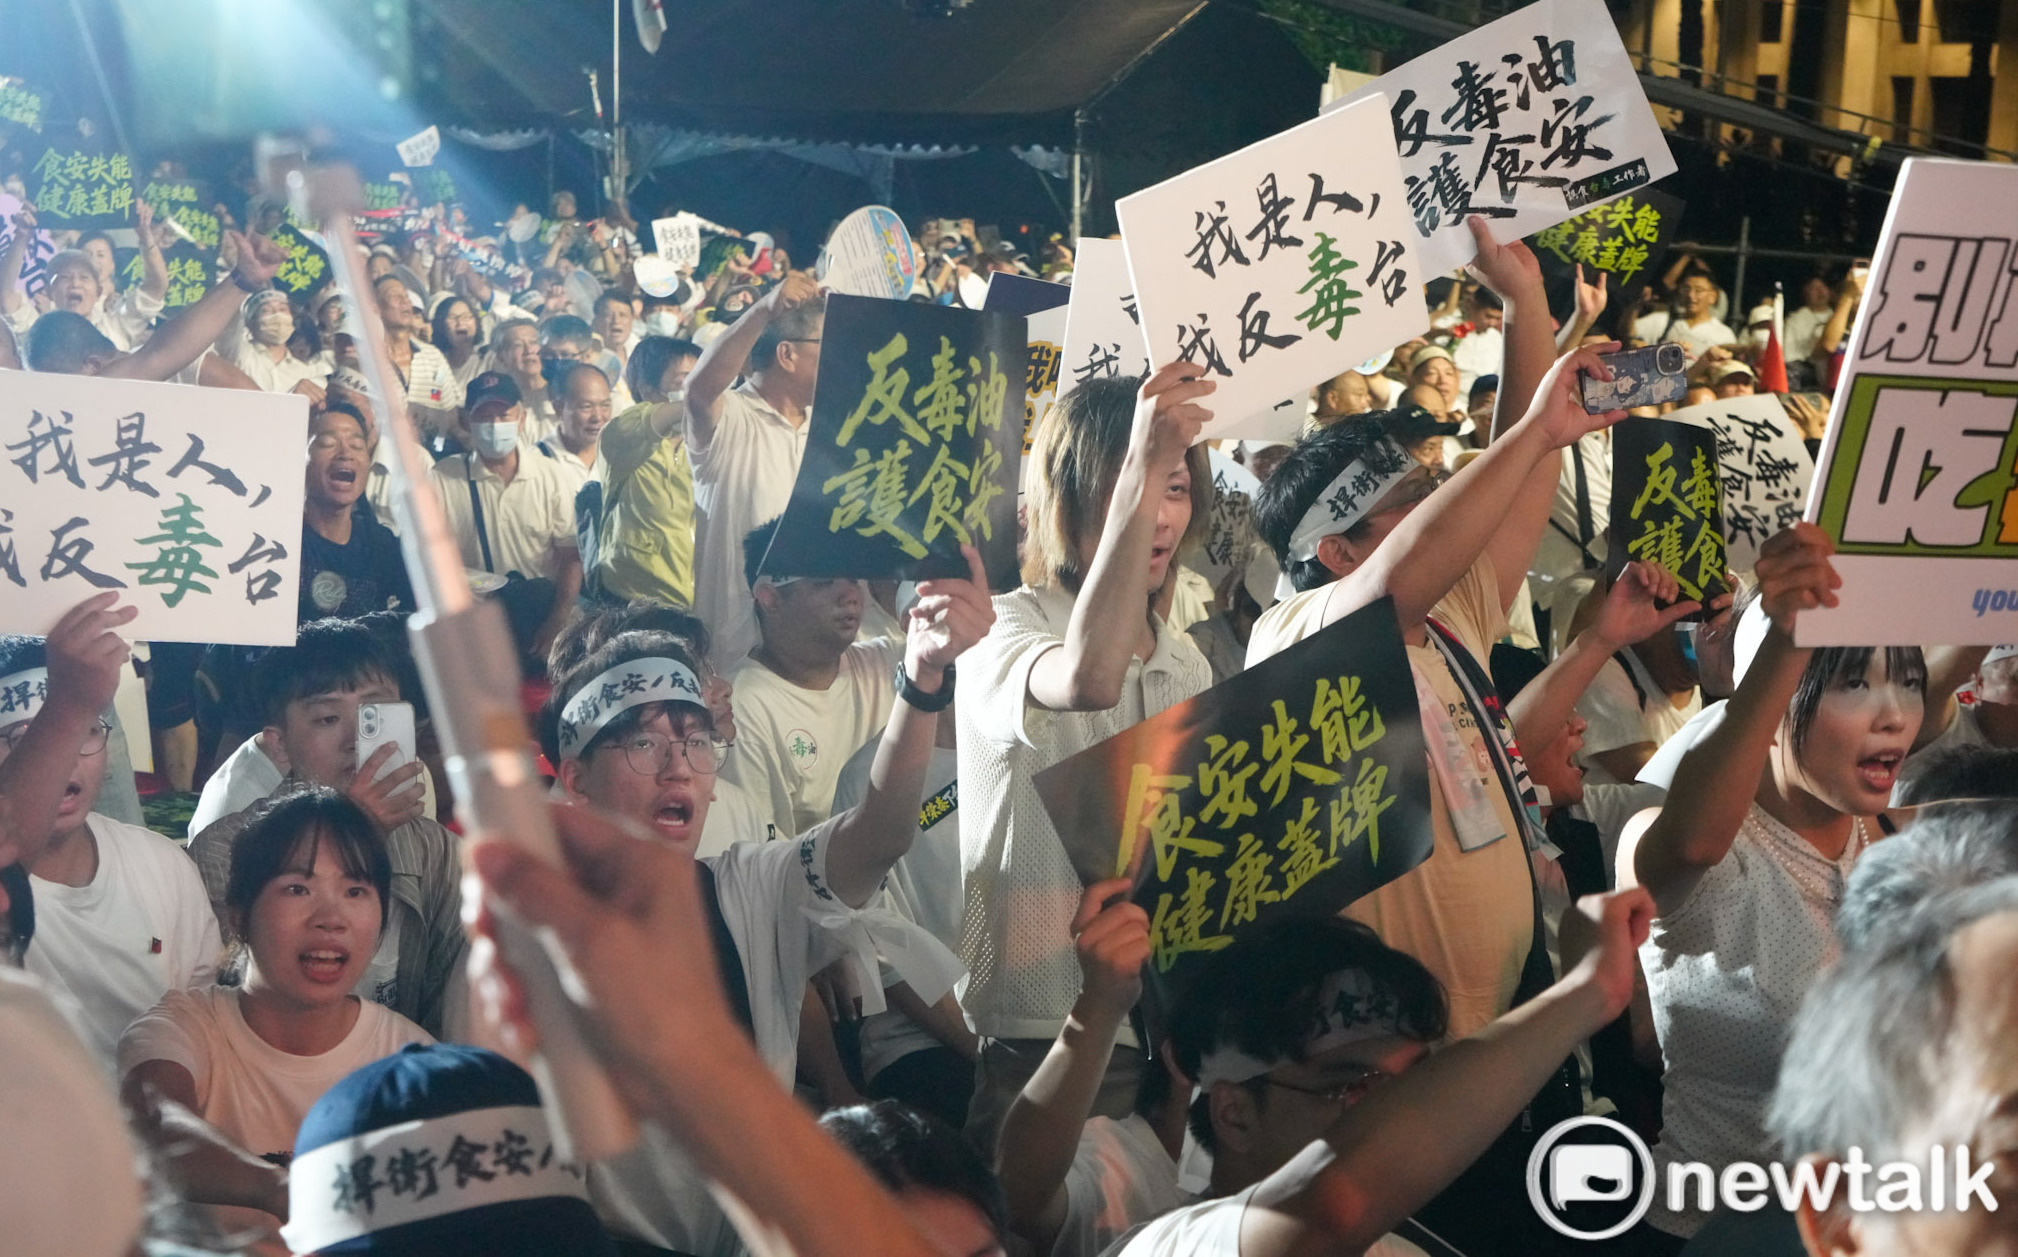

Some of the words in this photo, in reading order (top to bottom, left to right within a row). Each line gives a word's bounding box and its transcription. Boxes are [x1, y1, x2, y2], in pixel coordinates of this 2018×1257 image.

[1391, 35, 1577, 158] 反毒油
[33, 147, 133, 186] 食安失能
[36, 181, 135, 221] 健康蓋牌
[1405, 95, 1618, 238] 護食安
[1860, 233, 2018, 367] 別
[836, 331, 1008, 448] 反毒油
[823, 440, 1006, 559] 護食安
[1629, 441, 1724, 521] 反毒
[1840, 387, 2018, 548] 吃
[1628, 514, 1731, 601] 護食
[1116, 676, 1387, 883] 食安失能
[1150, 757, 1398, 974] 健康蓋牌
